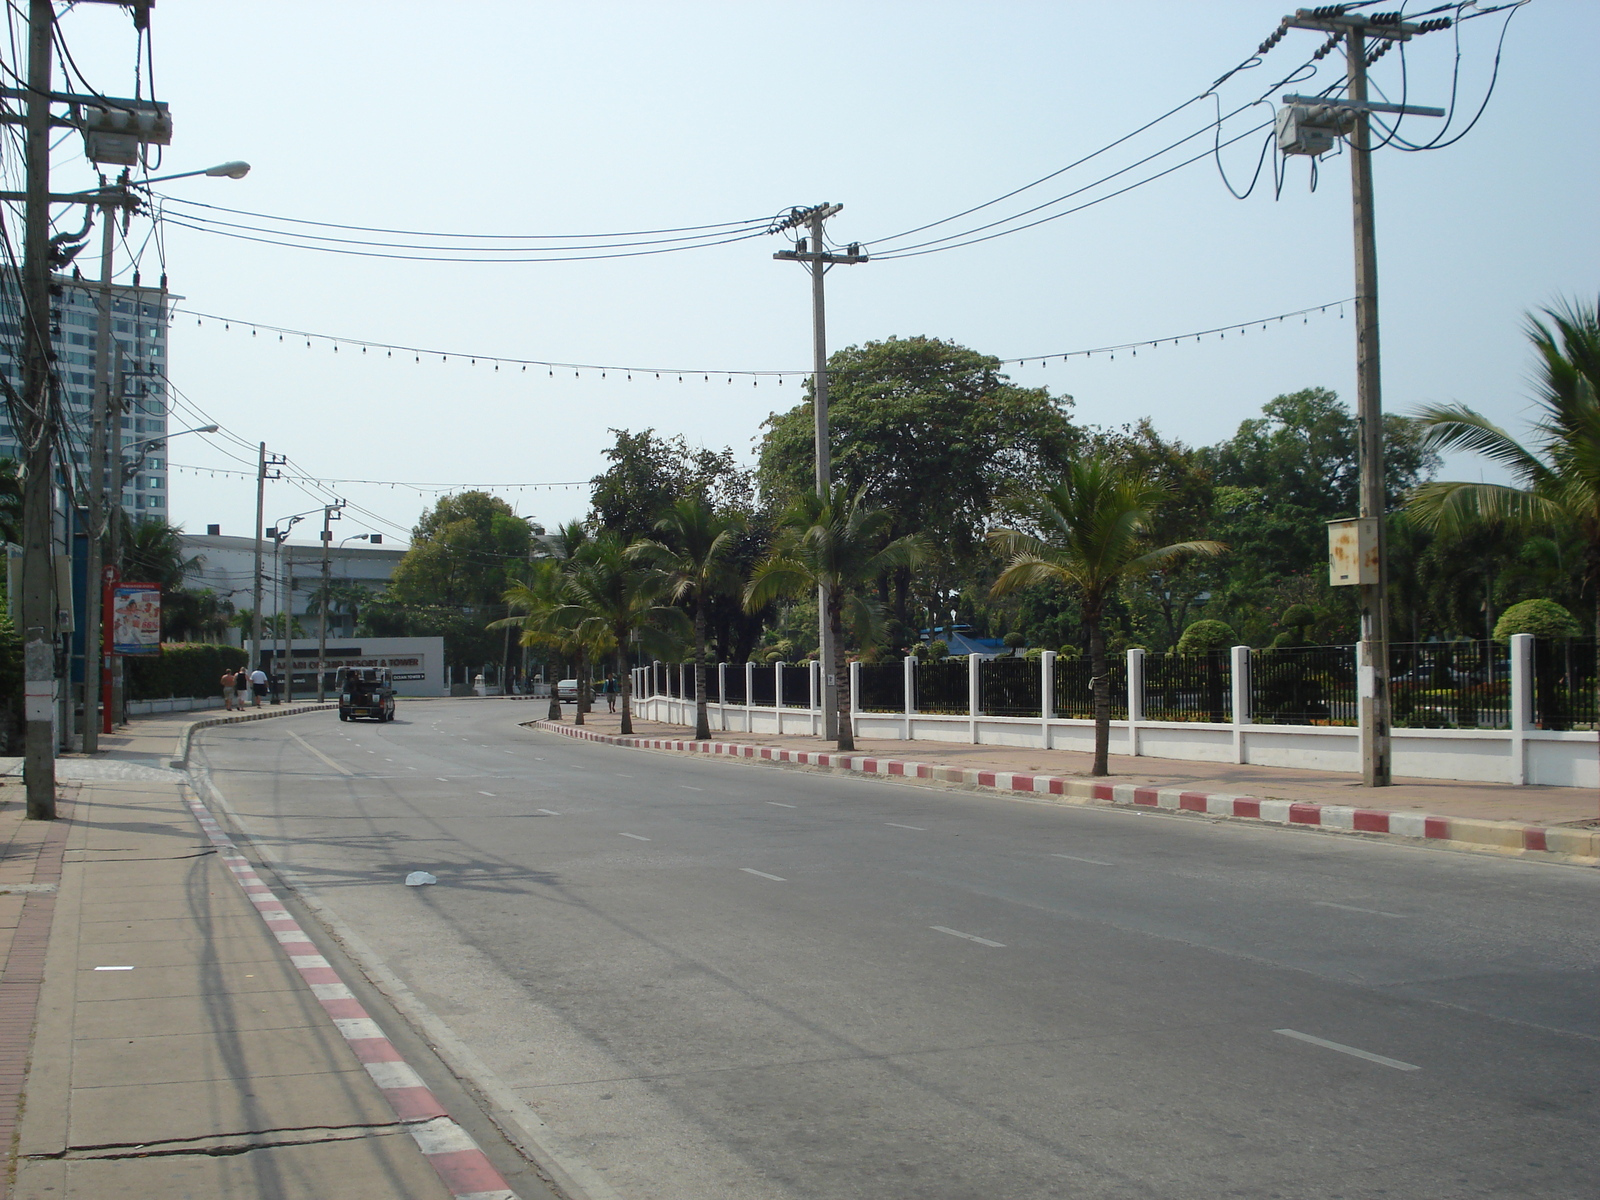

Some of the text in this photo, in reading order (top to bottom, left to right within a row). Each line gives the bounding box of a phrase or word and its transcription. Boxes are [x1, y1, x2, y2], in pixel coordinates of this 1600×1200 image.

[346, 659, 377, 667] RESORT
[379, 659, 387, 667] &
[388, 658, 419, 666] TOWER
